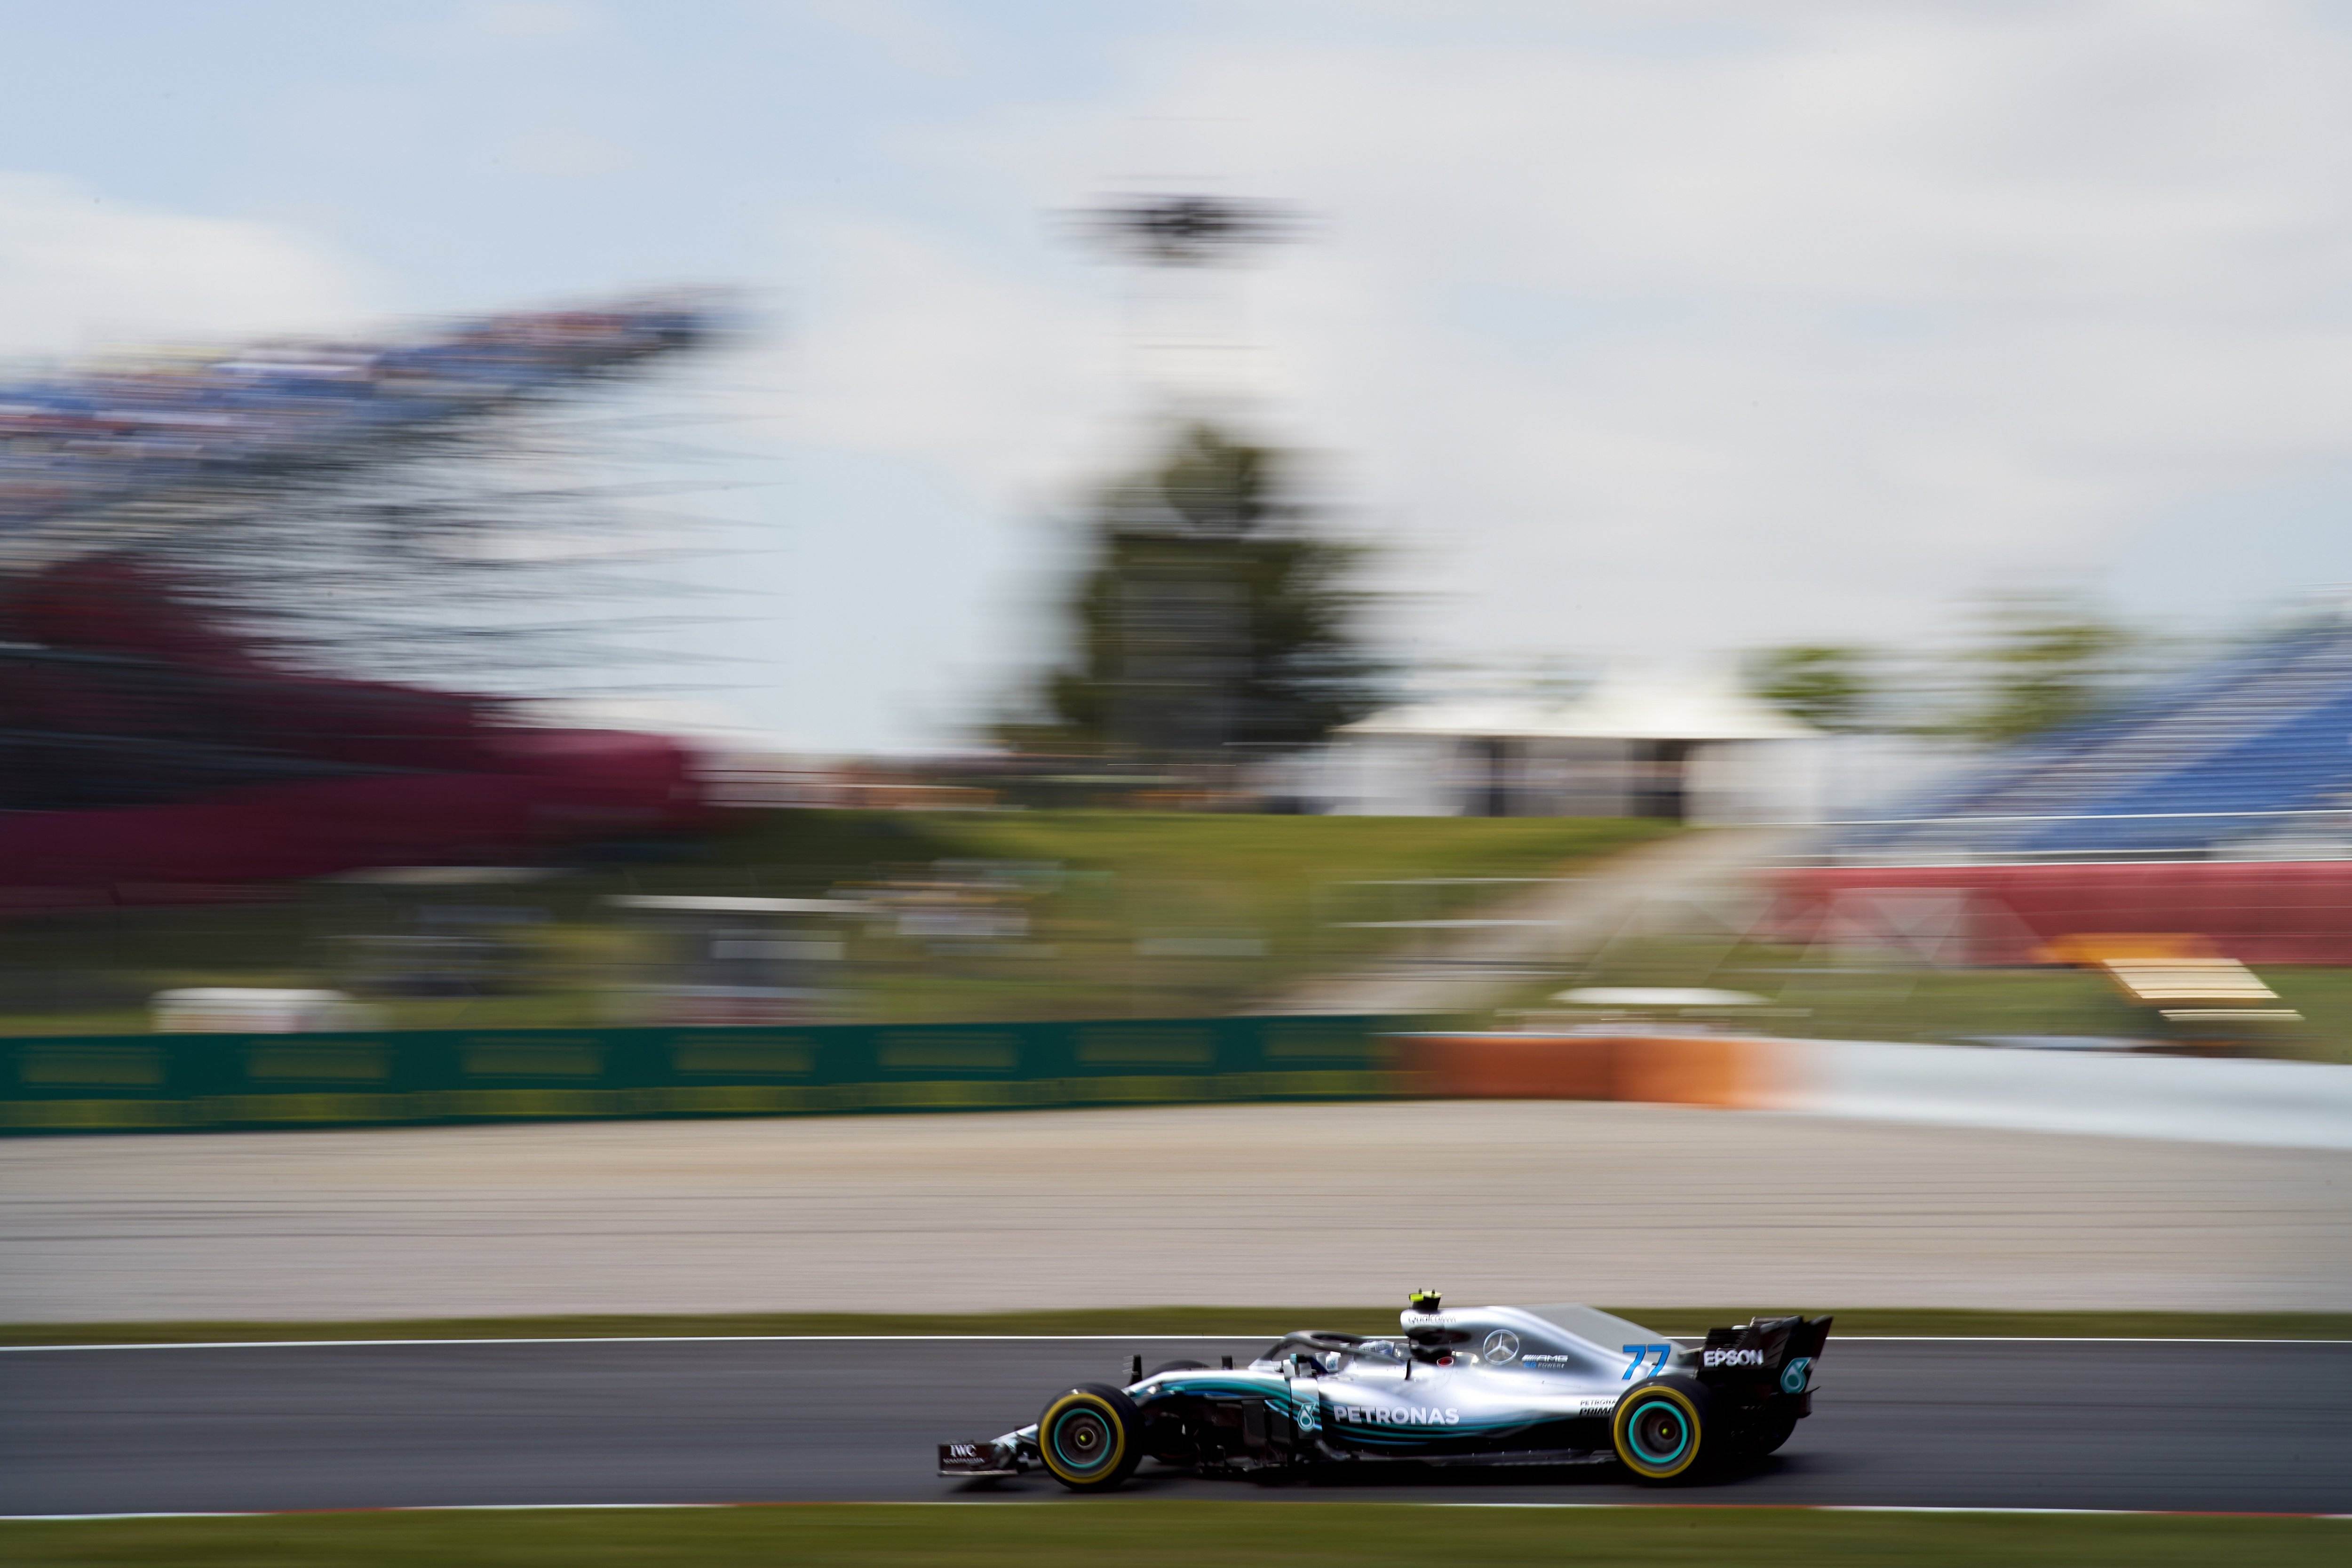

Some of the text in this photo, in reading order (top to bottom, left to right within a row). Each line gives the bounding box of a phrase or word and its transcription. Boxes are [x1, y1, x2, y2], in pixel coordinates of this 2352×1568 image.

[1408, 1313, 1456, 1325] Qualcomm
[1622, 1344, 1670, 1380] 77
[1703, 1350, 1764, 1367] EPSON
[1333, 1405, 1460, 1425] PETRONAS
[950, 1444, 977, 1457] IWC
